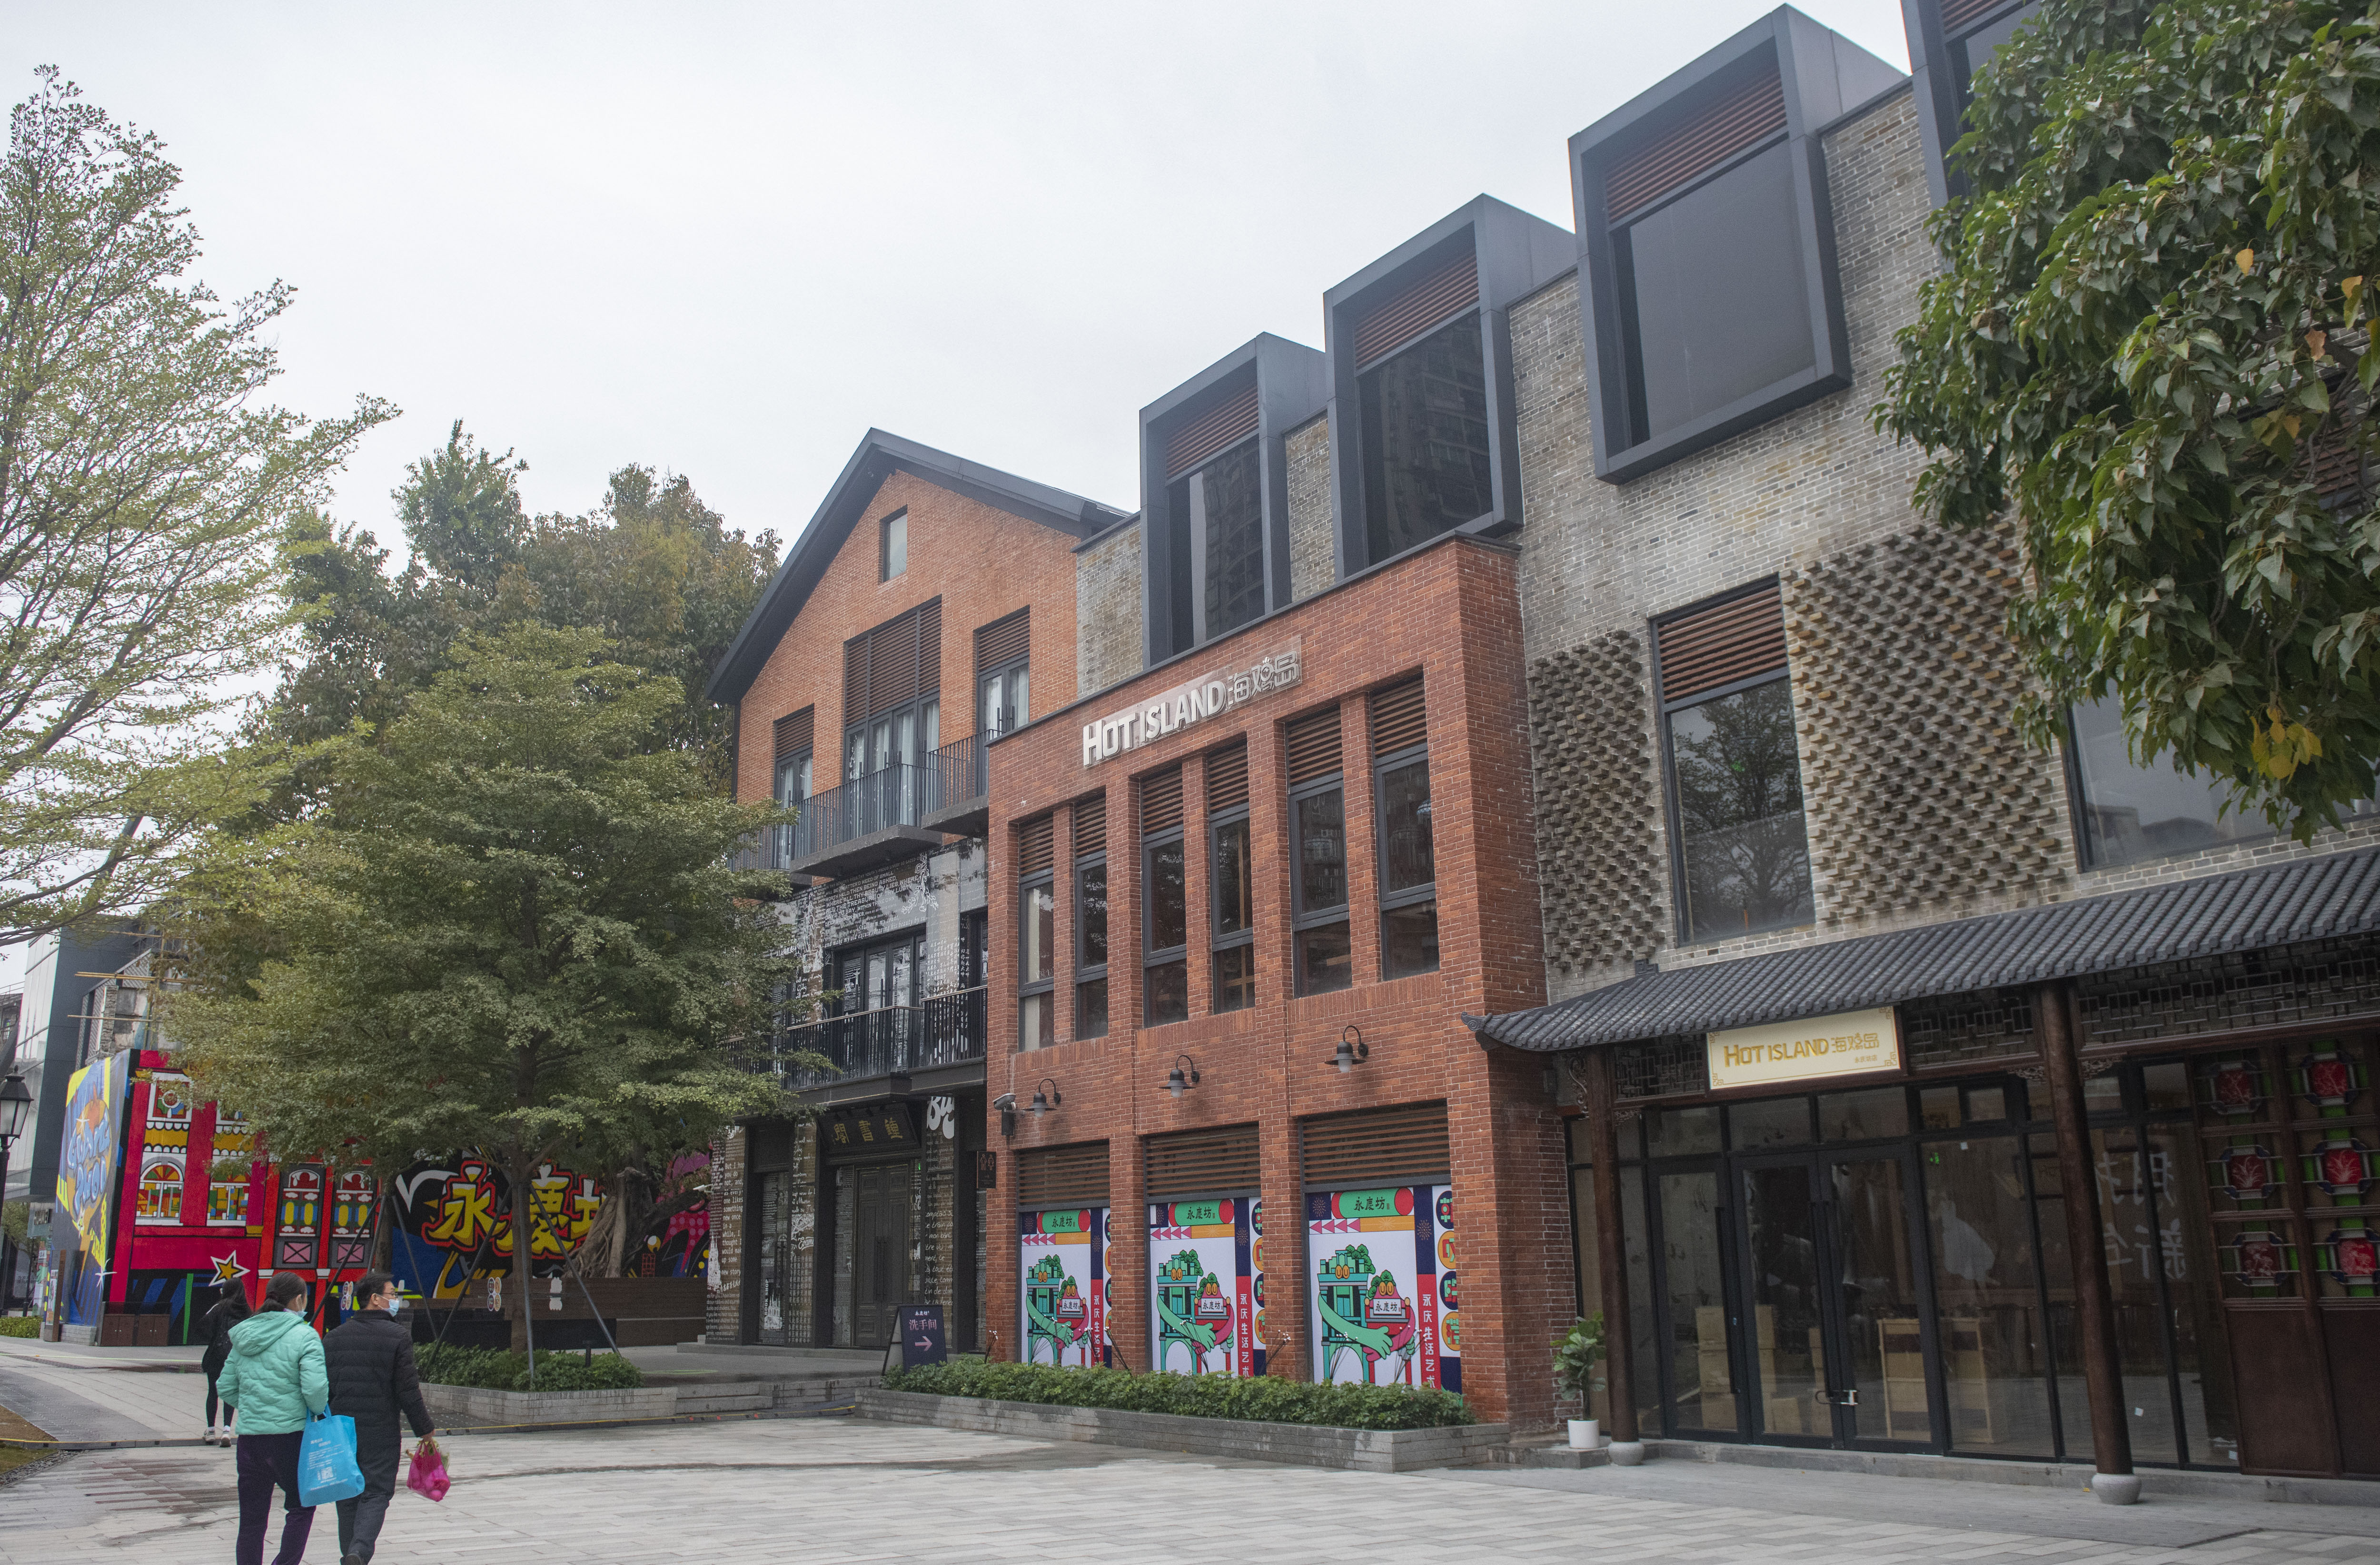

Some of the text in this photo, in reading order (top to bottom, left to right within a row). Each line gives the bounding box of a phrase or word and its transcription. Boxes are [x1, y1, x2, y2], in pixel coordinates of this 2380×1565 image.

[1083, 712, 1138, 767] HOT
[1139, 681, 1227, 743] ISLAND
[863, 882, 878, 890] BEING
[836, 903, 847, 911] THE
[895, 882, 913, 893] LUSTY
[826, 898, 843, 908] WHERE
[1724, 1044, 1764, 1068] HOT
[1767, 1038, 1829, 1062] ISLAND
[724, 1204, 743, 1213] something
[34, 1208, 49, 1226] HUAWEI
[722, 1239, 738, 1247] thought
[909, 1319, 938, 1331] 洗手间
